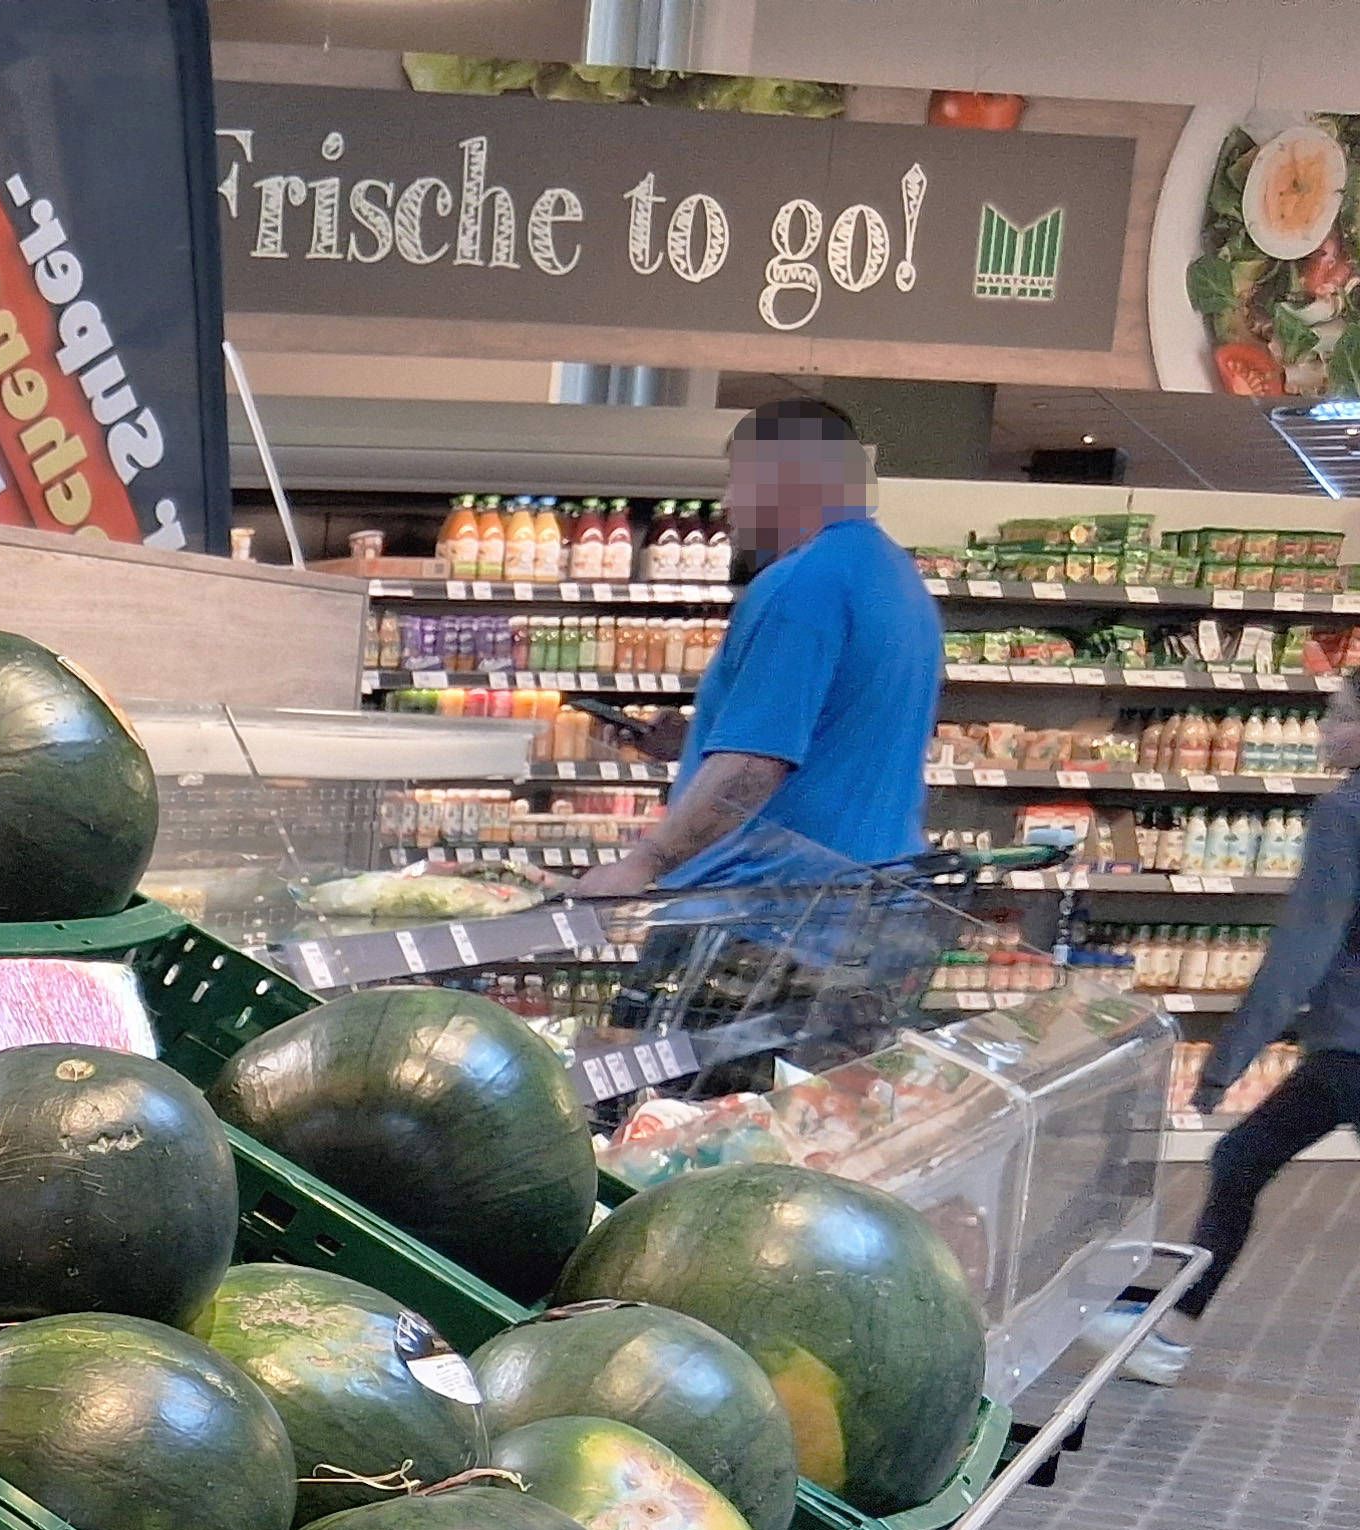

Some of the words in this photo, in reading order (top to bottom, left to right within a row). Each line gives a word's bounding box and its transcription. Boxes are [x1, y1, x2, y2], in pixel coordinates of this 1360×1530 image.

[623, 171, 730, 283] to
[758, 162, 928, 330] go!
[977, 276, 1054, 286] MARKTKAUF
